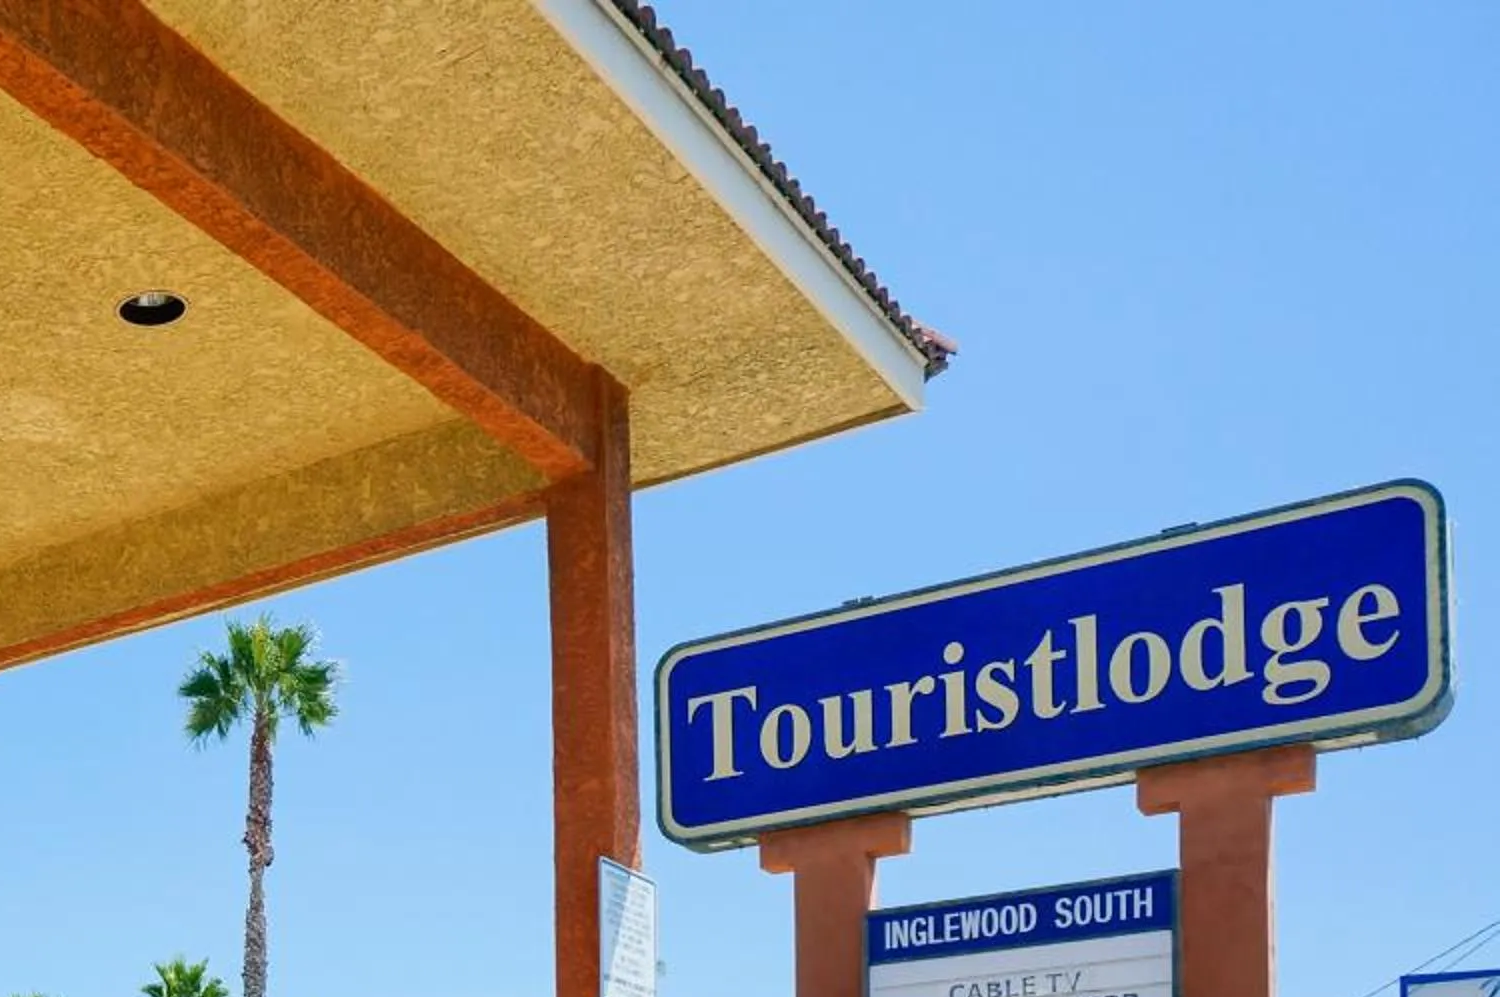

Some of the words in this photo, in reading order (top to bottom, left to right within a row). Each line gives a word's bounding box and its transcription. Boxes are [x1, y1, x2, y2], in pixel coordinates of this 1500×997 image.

[687, 583, 1400, 783] Touristlodge
[884, 903, 1037, 950] INGLEWOOD
[1054, 887, 1153, 929] SOUTH
[1045, 971, 1082, 993] TV
